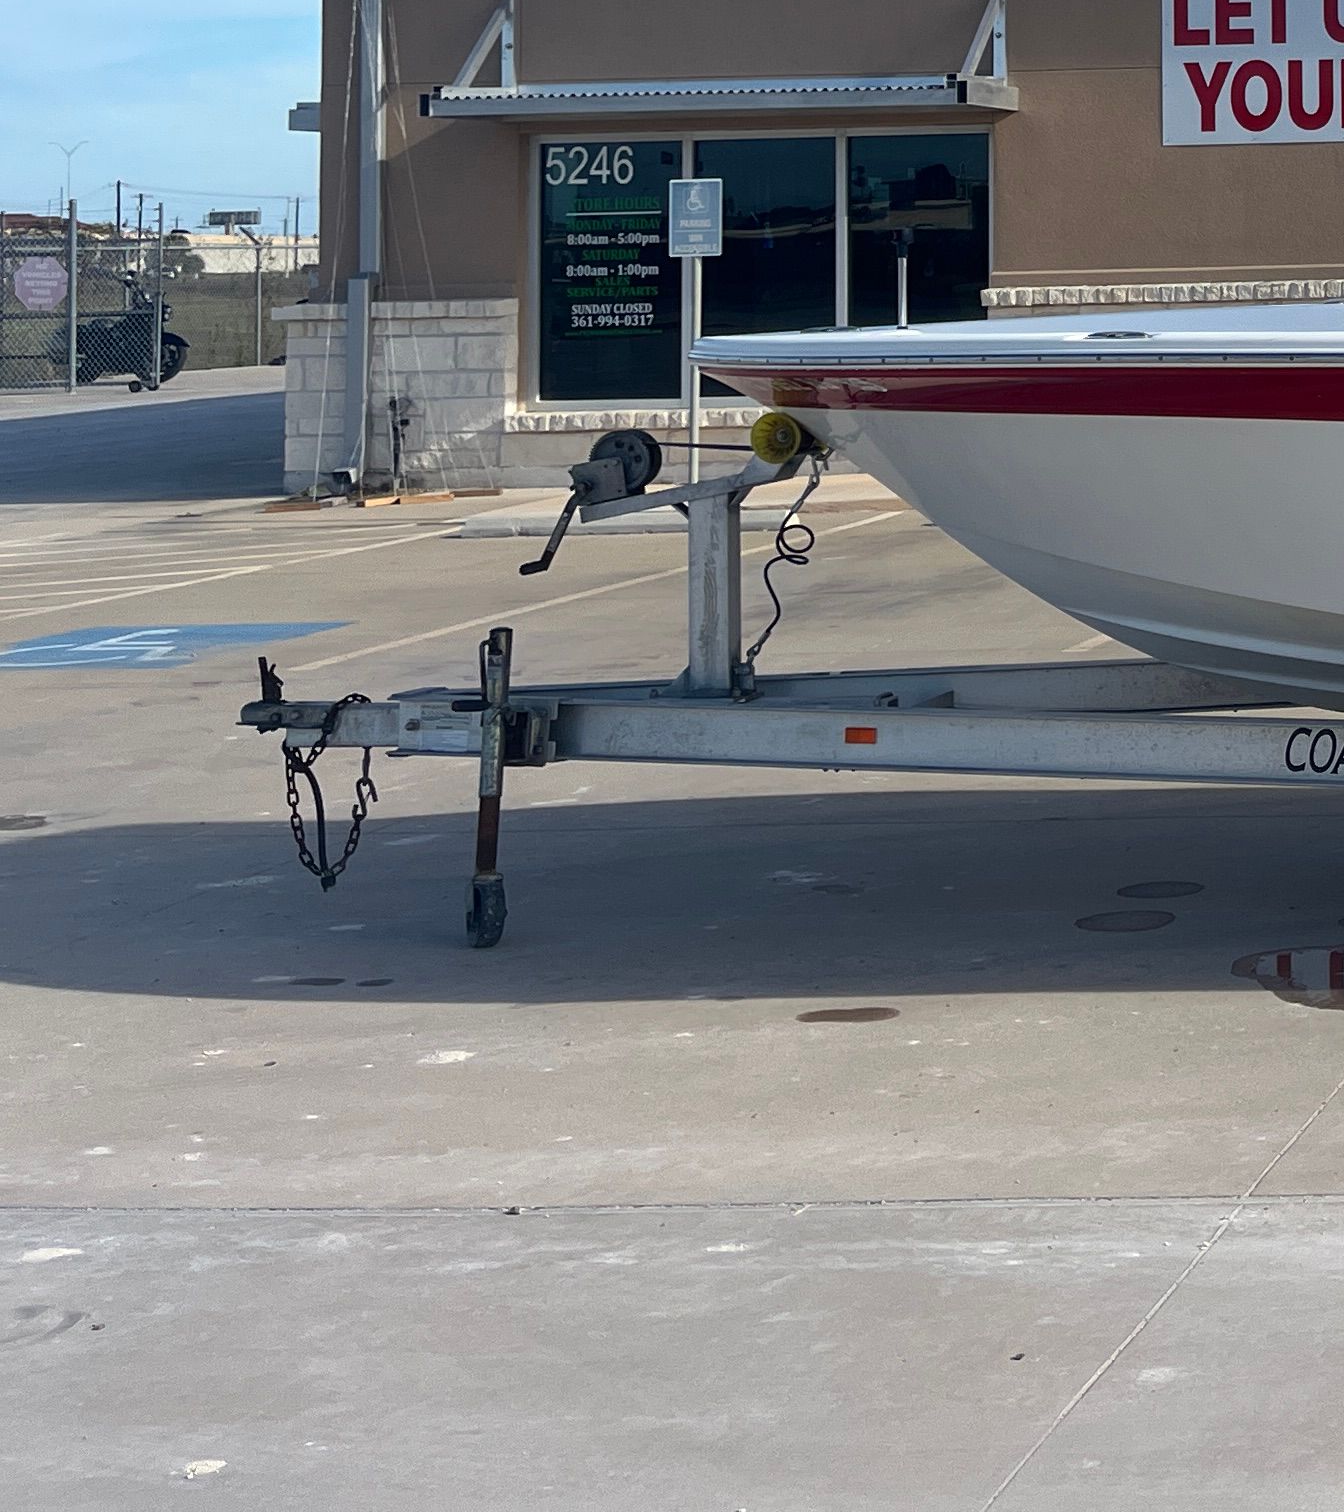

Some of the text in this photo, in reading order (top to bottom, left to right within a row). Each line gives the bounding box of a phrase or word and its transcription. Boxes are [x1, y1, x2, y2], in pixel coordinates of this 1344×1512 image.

[545, 145, 634, 185] 5246
[570, 196, 660, 211] TORE HOURS
[567, 233, 609, 246] 8:00am
[617, 232, 660, 246] 5:00pm
[582, 249, 640, 261] SATURDAY
[566, 265, 608, 277] 8:00am
[617, 264, 659, 278] 1:00pm
[596, 276, 631, 286] SALES
[571, 303, 653, 315] SUNDAY CLOSED
[571, 314, 654, 328] 361-994-0317
